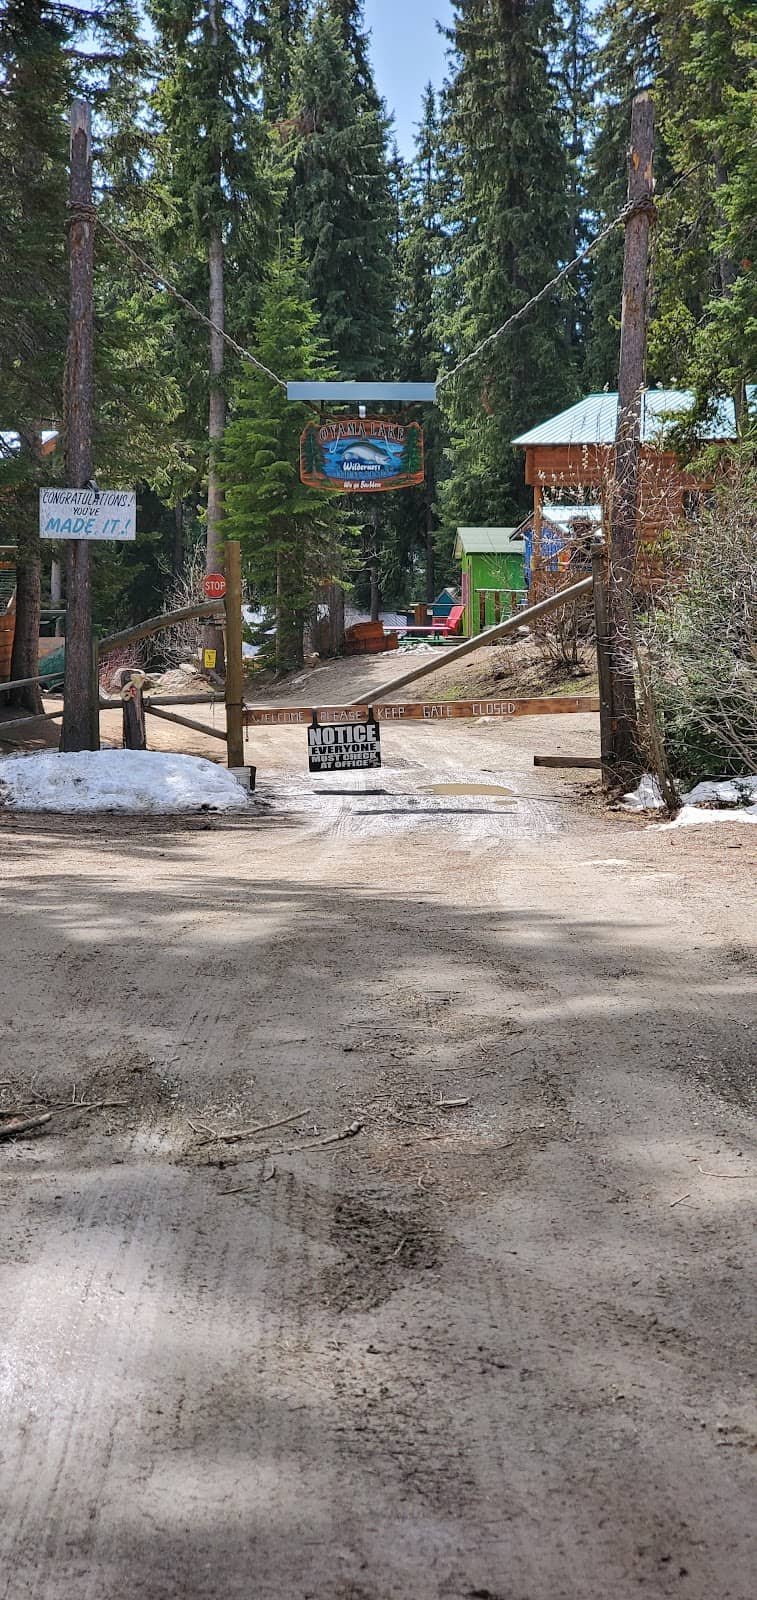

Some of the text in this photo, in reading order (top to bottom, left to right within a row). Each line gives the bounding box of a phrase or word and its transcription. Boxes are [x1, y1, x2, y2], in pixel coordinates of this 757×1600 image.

[319, 422, 406, 440] OYAMA LAKE
[343, 462, 381, 471] Wilderness
[43, 491, 134, 507] CONGRATULATIONS!
[45, 518, 131, 535] MADE IT!
[205, 581, 225, 590] STOP
[251, 702, 516, 723] WELCOME PLEASE KEEP GATE CLOSED
[309, 724, 377, 746] NOTICE
[311, 742, 377, 755] EVERYONE
[311, 752, 377, 763] MUST CHECK
[320, 759, 369, 769] AT OFFICE
